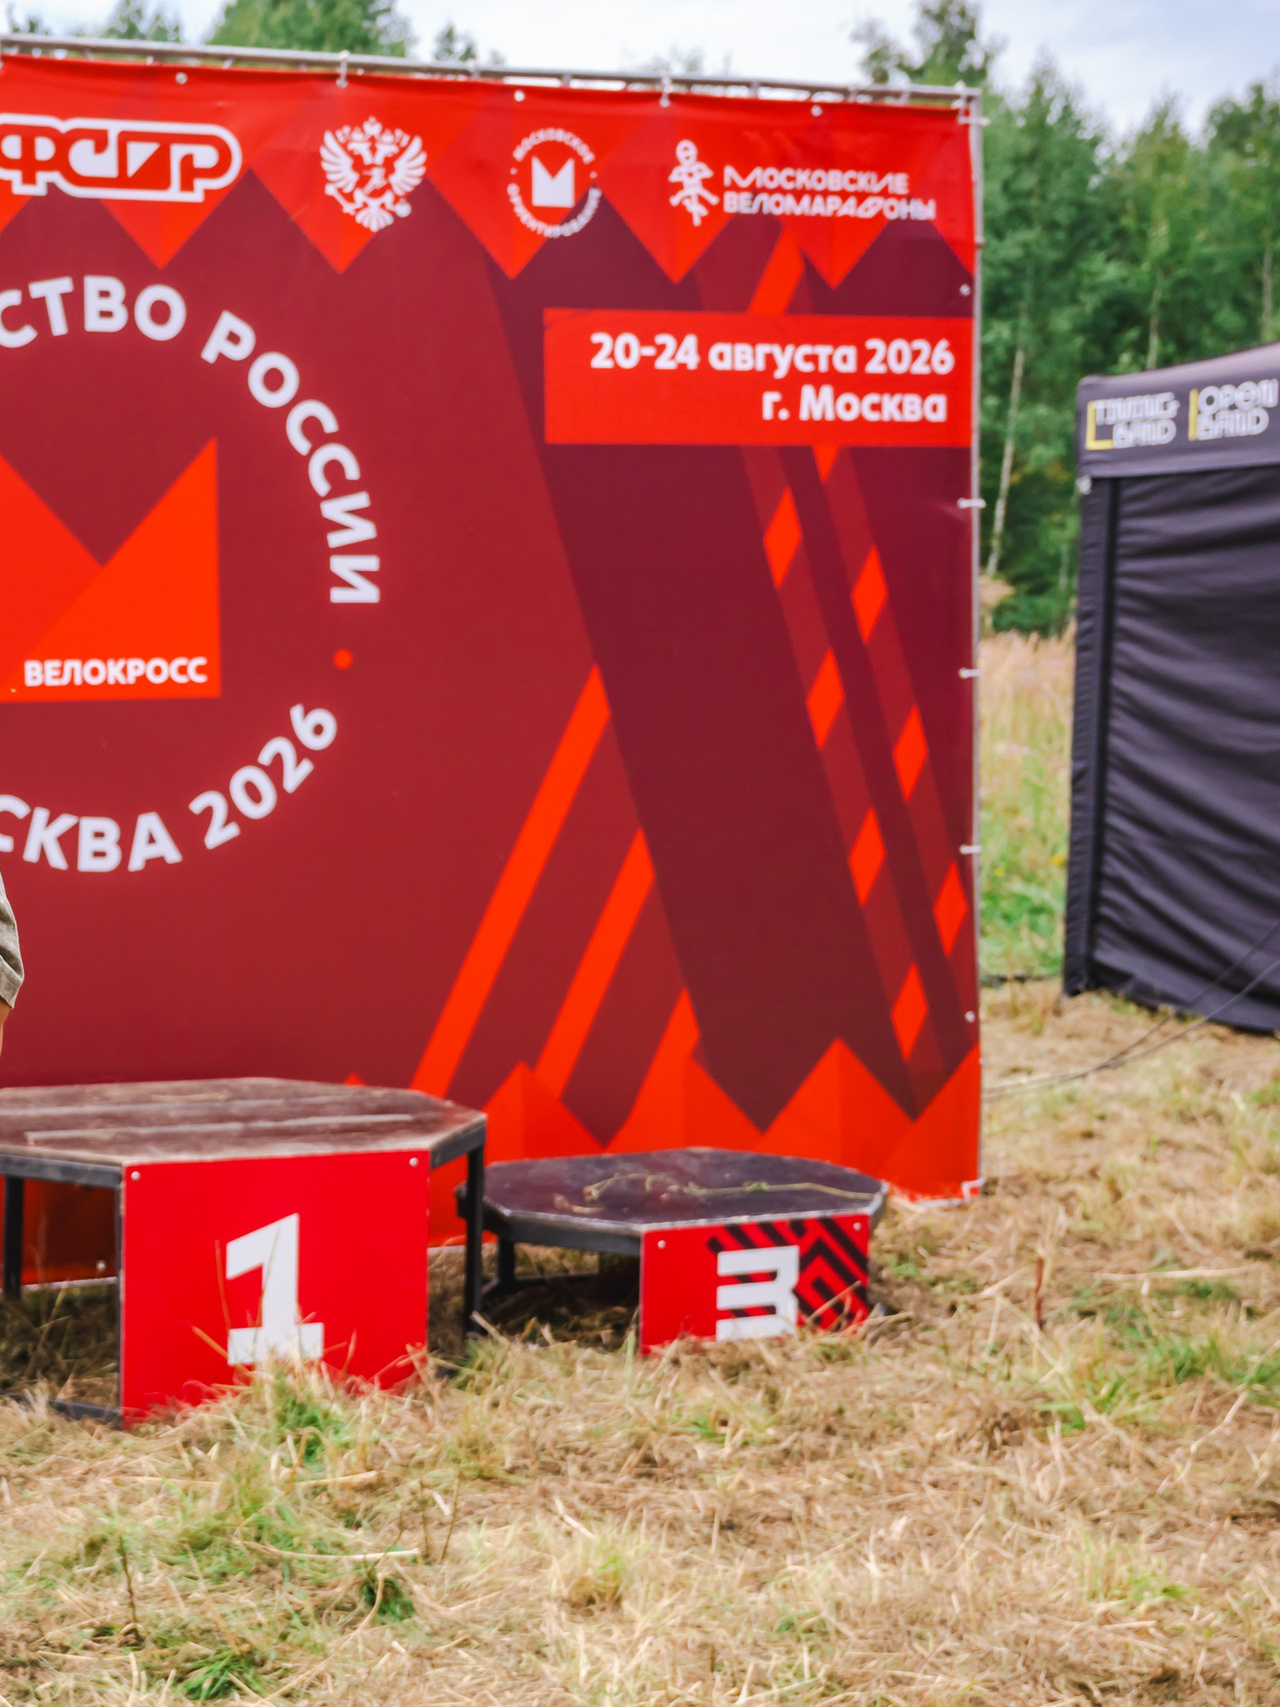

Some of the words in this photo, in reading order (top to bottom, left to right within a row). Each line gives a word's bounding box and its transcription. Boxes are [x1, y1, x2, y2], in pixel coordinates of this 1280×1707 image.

[723, 165, 910, 195] МОСКОВСКИЕ
[723, 190, 937, 221] ВЕЛОМАРАФОНЫ
[590, 331, 701, 371] 20-24
[707, 342, 858, 380] августа
[863, 338, 956, 375] 2026
[762, 391, 790, 421] г.
[798, 384, 948, 423] Москва
[200, 310, 381, 604] РОССИИ
[23, 656, 209, 688] ВЕЛОКРОСС
[188, 703, 338, 850] 2026
[226, 1211, 324, 1367] 1
[716, 1244, 800, 1342] 3
